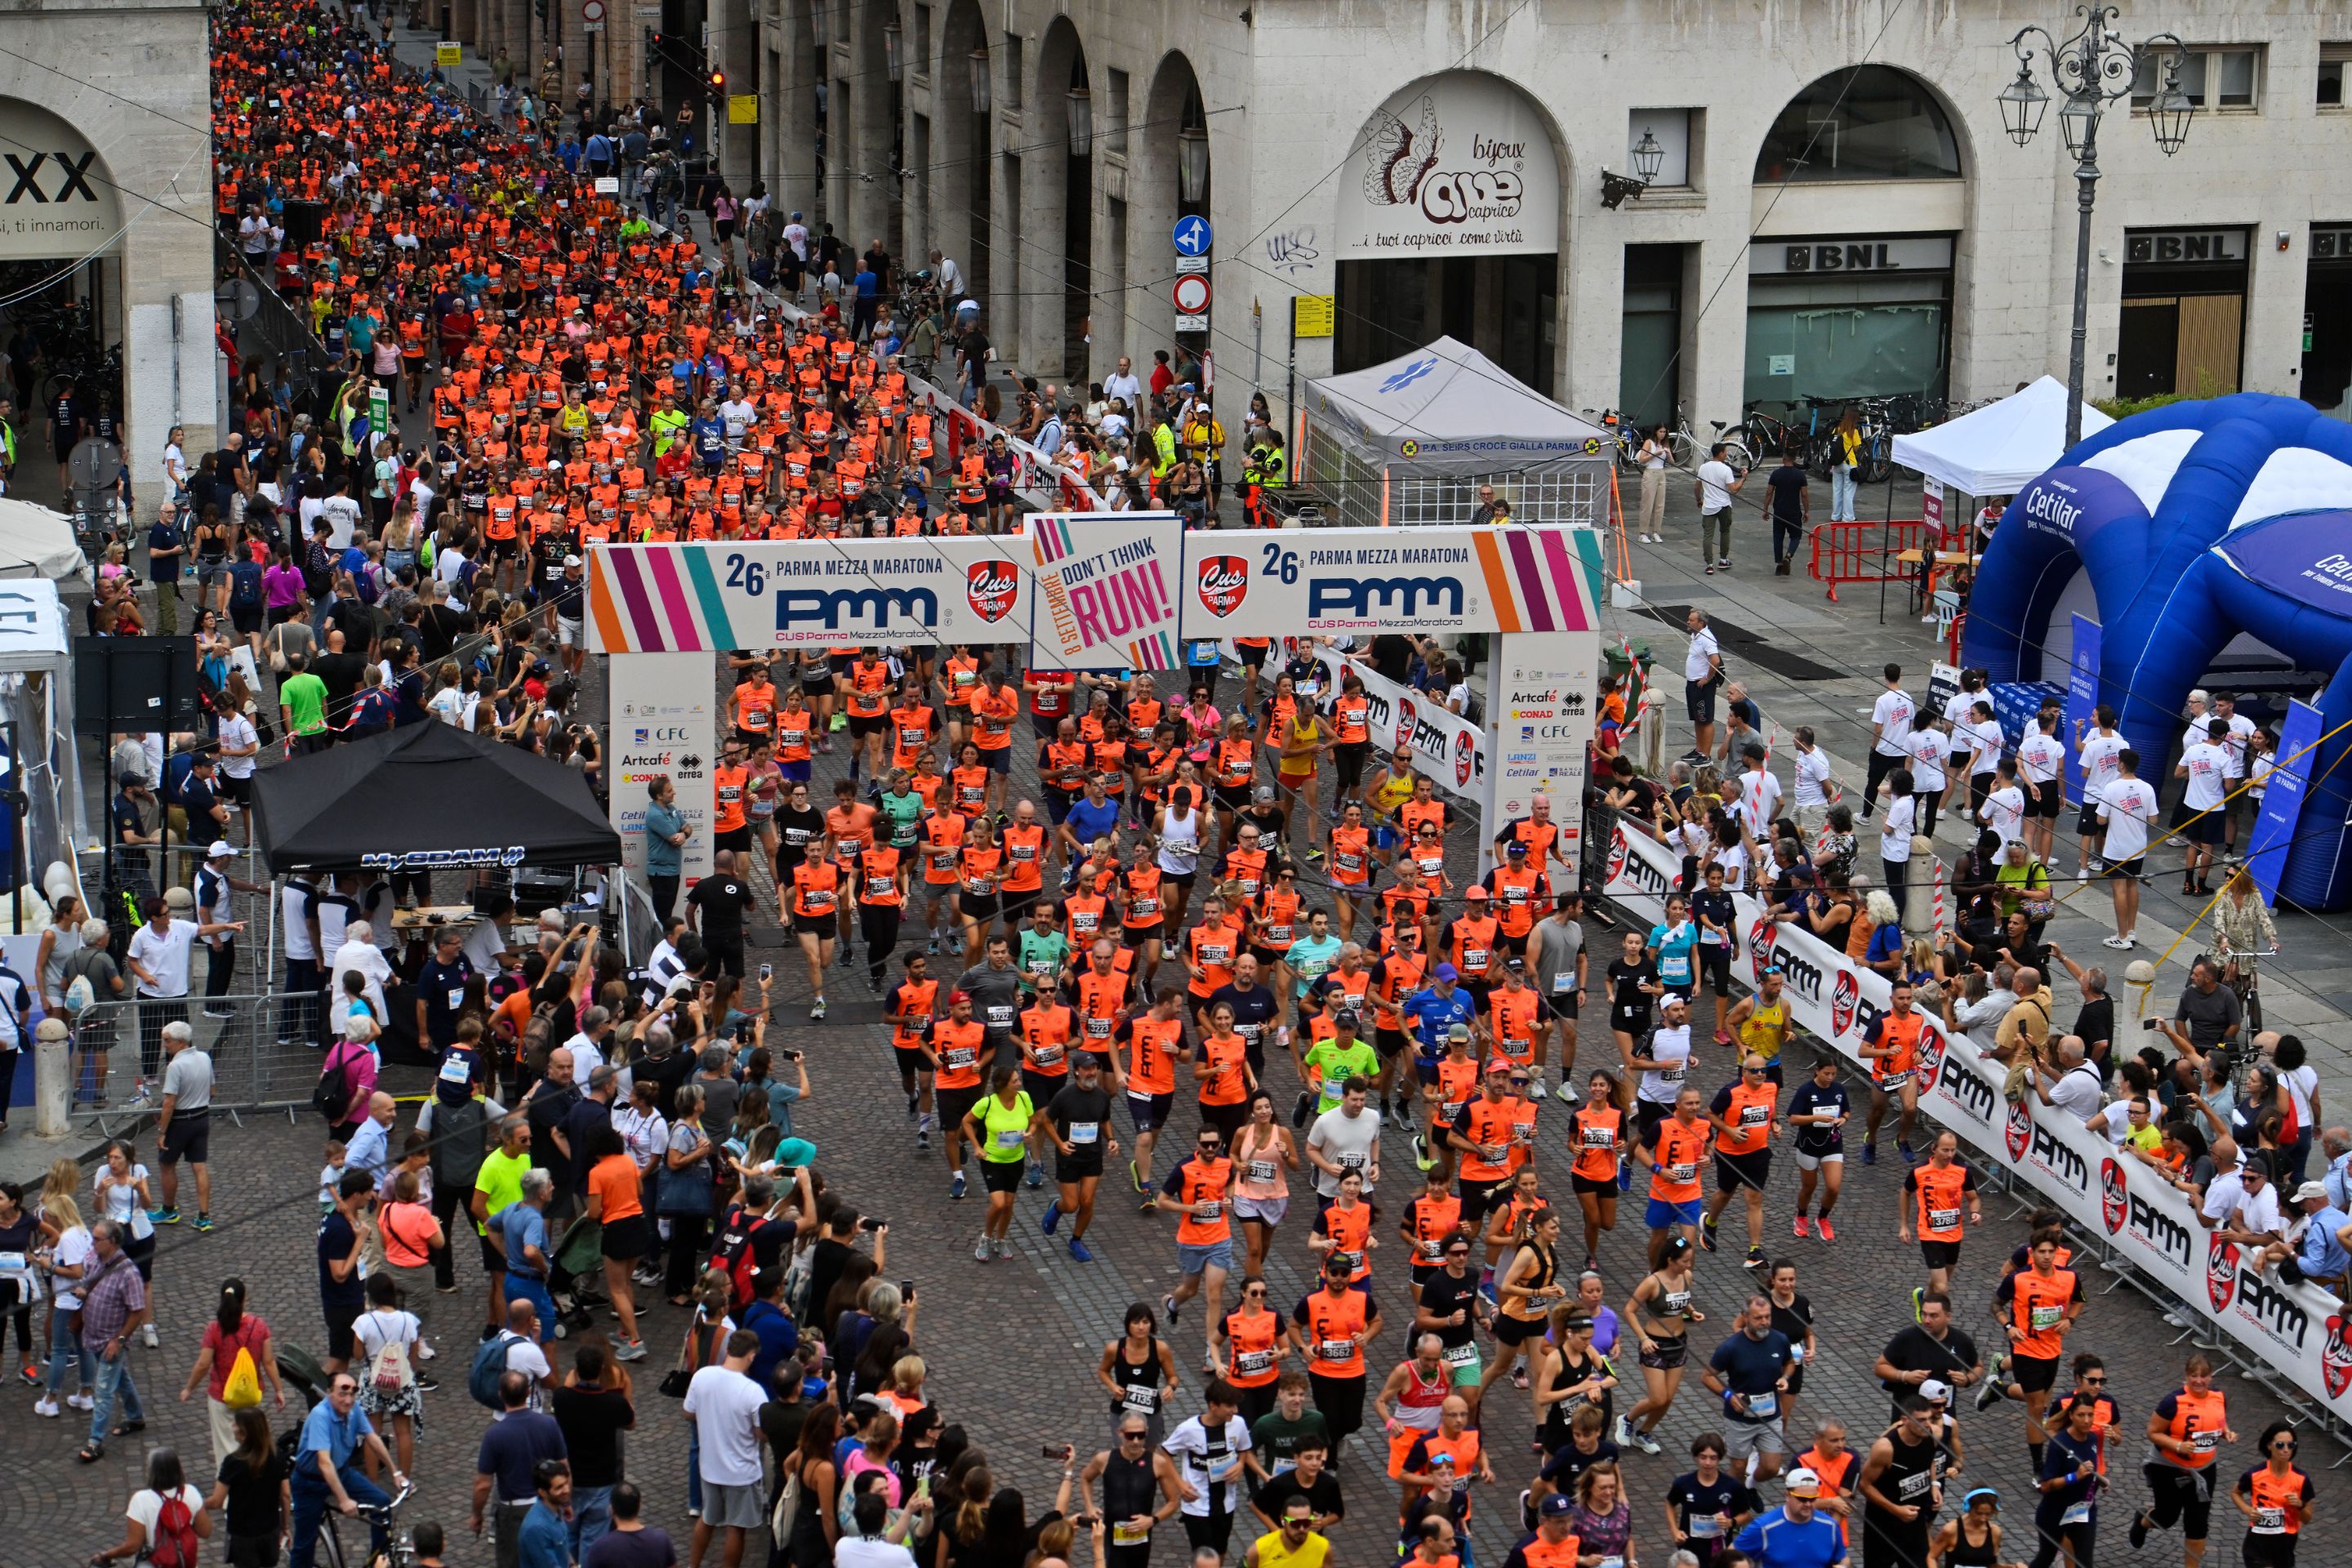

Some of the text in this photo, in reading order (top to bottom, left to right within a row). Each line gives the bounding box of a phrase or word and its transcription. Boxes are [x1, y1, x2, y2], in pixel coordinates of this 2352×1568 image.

[1472, 133, 1526, 167] bijoux
[1468, 203, 1516, 223] caprice
[16, 216, 105, 233] ti innamori.
[1375, 232, 1400, 247] tuoi
[1402, 231, 1453, 250] capricci
[1458, 232, 1491, 245] come
[2158, 234, 2234, 261] BNL
[1816, 243, 1900, 270] BNL
[1472, 442, 1506, 451] CROCE
[1509, 441, 1545, 450] GIALLA
[1546, 441, 1579, 451] PARMA
[2026, 486, 2082, 531] Cetilar
[1062, 536, 1156, 586] DON'T THINK
[1310, 550, 1353, 565] PARMA
[1356, 549, 1398, 564] MEZZA
[1402, 548, 1469, 564] MARATONA
[777, 560, 822, 577] PARMA
[825, 559, 868, 575] MEZZA
[873, 558, 943, 574] MARATONA
[1200, 564, 1245, 596] Cus
[969, 570, 1015, 602] Cus
[978, 600, 1007, 612] PARMA
[1068, 559, 1175, 649] RUN!
[1208, 595, 1236, 607] PARMA
[1041, 571, 1082, 657] 8 SETTEMBRE
[1511, 689, 1558, 703] Artcafé
[1520, 710, 1553, 719] CONAD
[1561, 708, 1585, 716] errea
[657, 728, 689, 741] CFC
[1541, 725, 1571, 738] CFC
[905, 734, 922, 742] 3480
[621, 751, 671, 766] Artcafé
[678, 770, 702, 779] errea
[1507, 768, 1540, 777] Cetilar
[722, 791, 737, 799] 3571
[965, 792, 981, 800] 3281
[789, 834, 806, 842] 3241
[841, 844, 858, 853] 3577
[1423, 863, 1440, 871] 4051
[1136, 904, 1154, 914] 3308
[1076, 917, 1094, 926] 3258
[1270, 932, 1289, 940] 3496
[1205, 951, 1224, 960] 3150
[1468, 955, 1486, 964] 3914
[991, 1013, 1009, 1021] 3732
[1090, 1023, 1108, 1033] 3223
[1507, 1045, 1526, 1054] 3107
[1747, 1111, 1766, 1121] 3729
[1342, 1157, 1362, 1167] 3187
[1250, 1166, 1272, 1178] 3186
[1936, 1215, 1955, 1225] 3786
[2210, 1244, 2234, 1278] Cus
[1326, 1348, 1350, 1357] 3662
[1447, 1349, 1471, 1360] 3664
[1129, 1392, 1152, 1405] 4135
